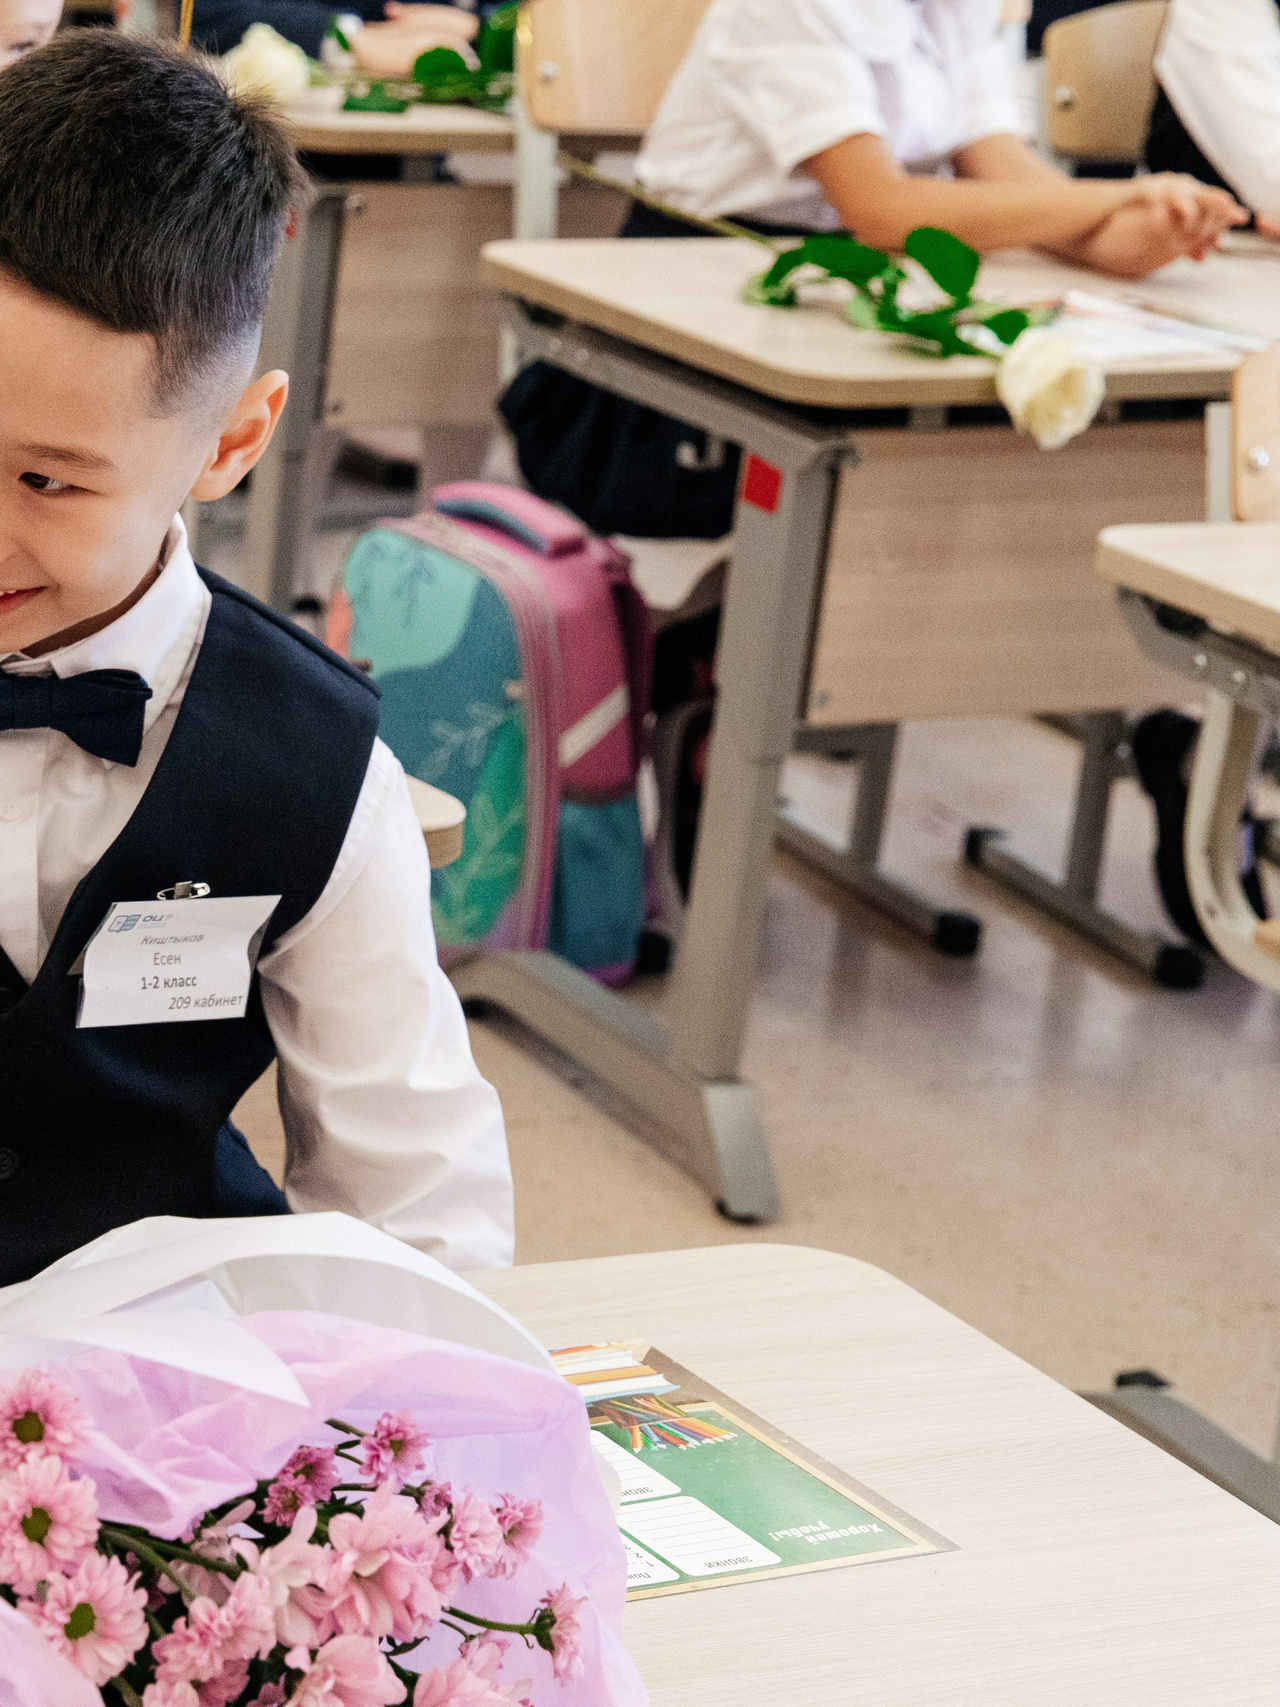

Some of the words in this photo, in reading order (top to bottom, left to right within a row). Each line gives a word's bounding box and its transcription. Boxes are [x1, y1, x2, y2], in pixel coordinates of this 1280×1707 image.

[153, 952, 181, 966] Есен
[140, 976, 160, 990] 1-2
[163, 974, 198, 988] класс
[168, 996, 191, 1010] 209
[193, 993, 244, 1008] кабинет
[621, 1486, 654, 1497] ЗВОН
[805, 1523, 885, 1546] Хорошей
[703, 1556, 754, 1570] ЗВОНКИ
